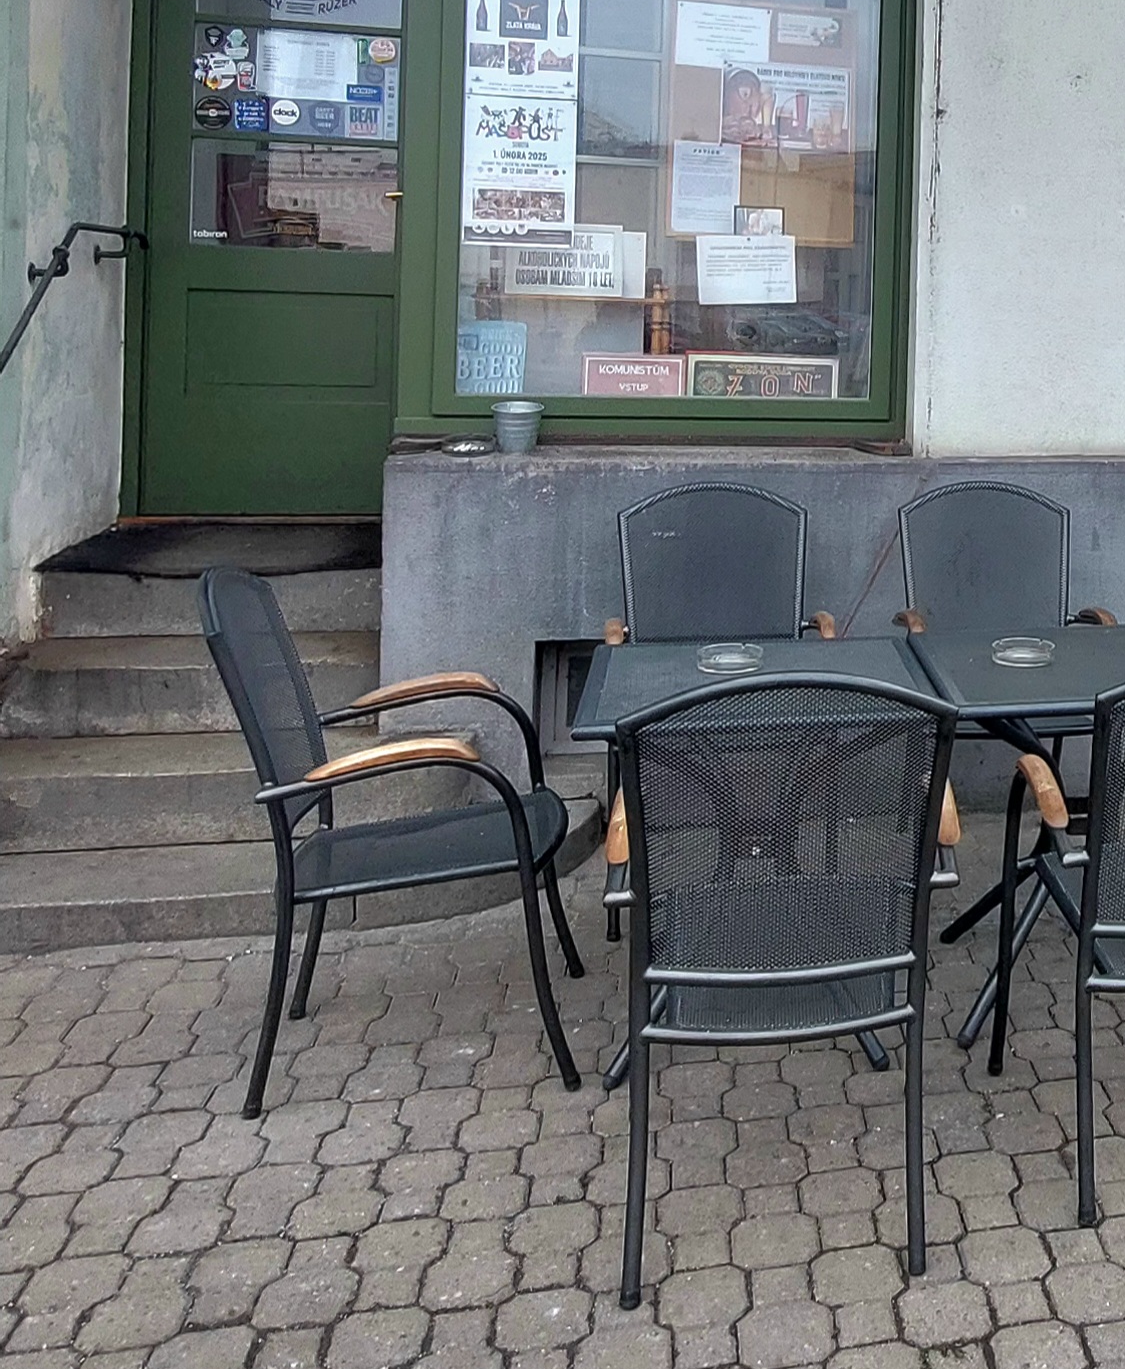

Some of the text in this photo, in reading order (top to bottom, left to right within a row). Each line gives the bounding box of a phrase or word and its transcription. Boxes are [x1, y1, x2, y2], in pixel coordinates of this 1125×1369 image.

[350, 106, 380, 123] BEAT
[500, 148, 526, 160] ÚNORA
[528, 152, 548, 161] 2025
[481, 342, 523, 356] GOOD
[458, 355, 522, 380] BEER
[599, 364, 669, 376] KOMUNISTŮM
[619, 382, 649, 392] VSTUP
